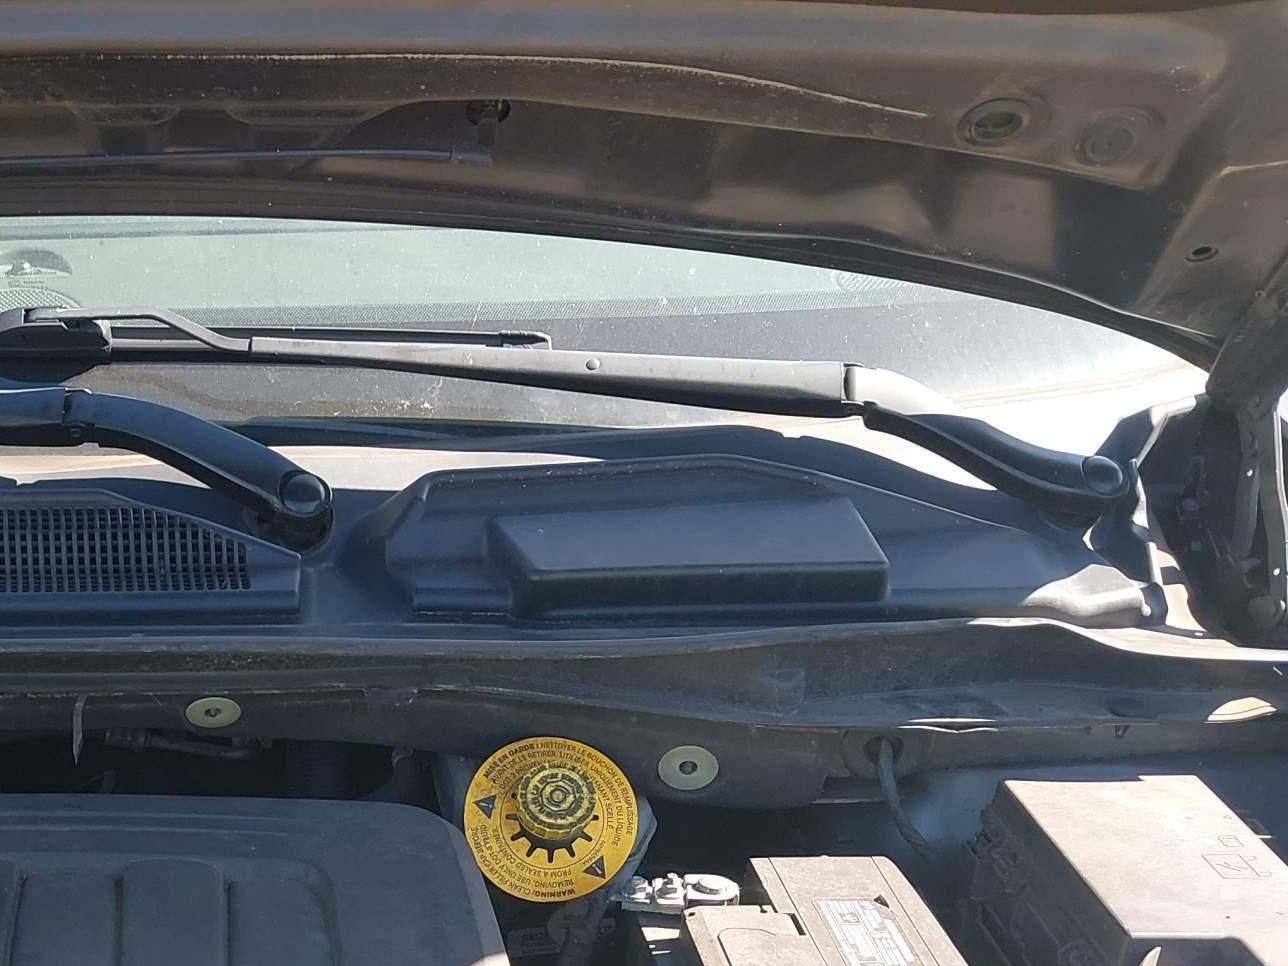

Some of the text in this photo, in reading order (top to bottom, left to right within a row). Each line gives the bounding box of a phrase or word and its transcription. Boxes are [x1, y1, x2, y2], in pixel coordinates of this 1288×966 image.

[508, 757, 519, 768] DE
[498, 753, 510, 764] EN
[538, 741, 577, 752] NETTOYER
[585, 750, 618, 778] BOUCHON
[619, 786, 633, 835] REMPLISSAGE
[470, 826, 484, 854] BEFORE
[478, 852, 492, 867] CAP
[486, 864, 510, 885] FILLER
[498, 862, 517, 879] ONLY
[514, 860, 541, 877] SEALED
[549, 867, 572, 878] FROM
[507, 880, 531, 895] CLEAN
[515, 874, 531, 886] USE
